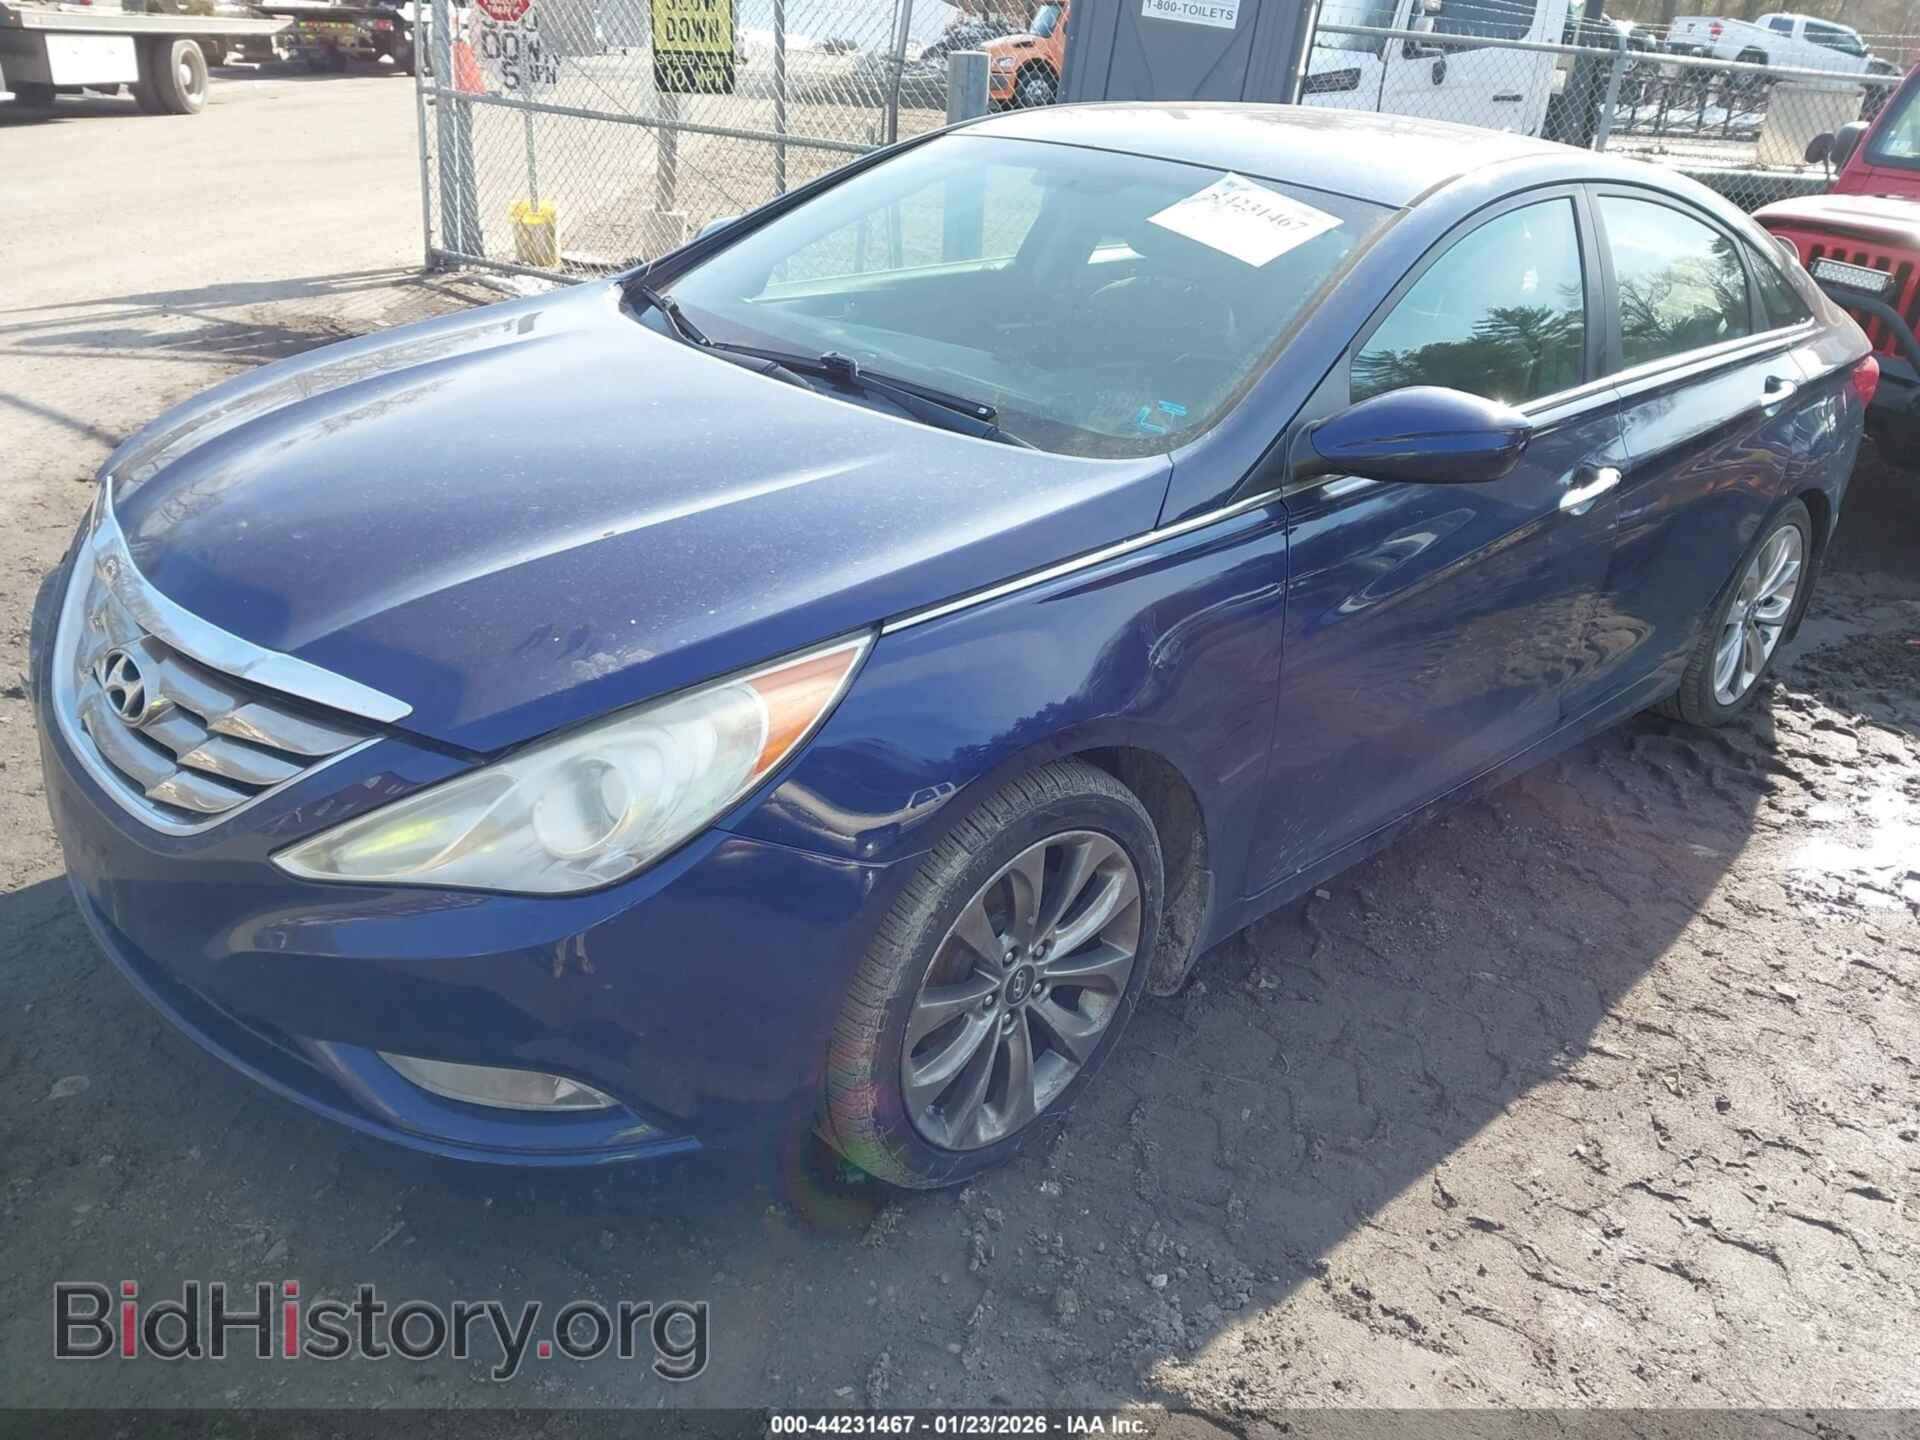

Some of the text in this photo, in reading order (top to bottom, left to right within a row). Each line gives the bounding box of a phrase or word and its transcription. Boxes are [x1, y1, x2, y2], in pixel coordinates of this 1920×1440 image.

[1147, 0, 1234, 21] 1-800-TOILETS
[666, 17, 719, 43] DOWN
[656, 54, 695, 66] SPEED
